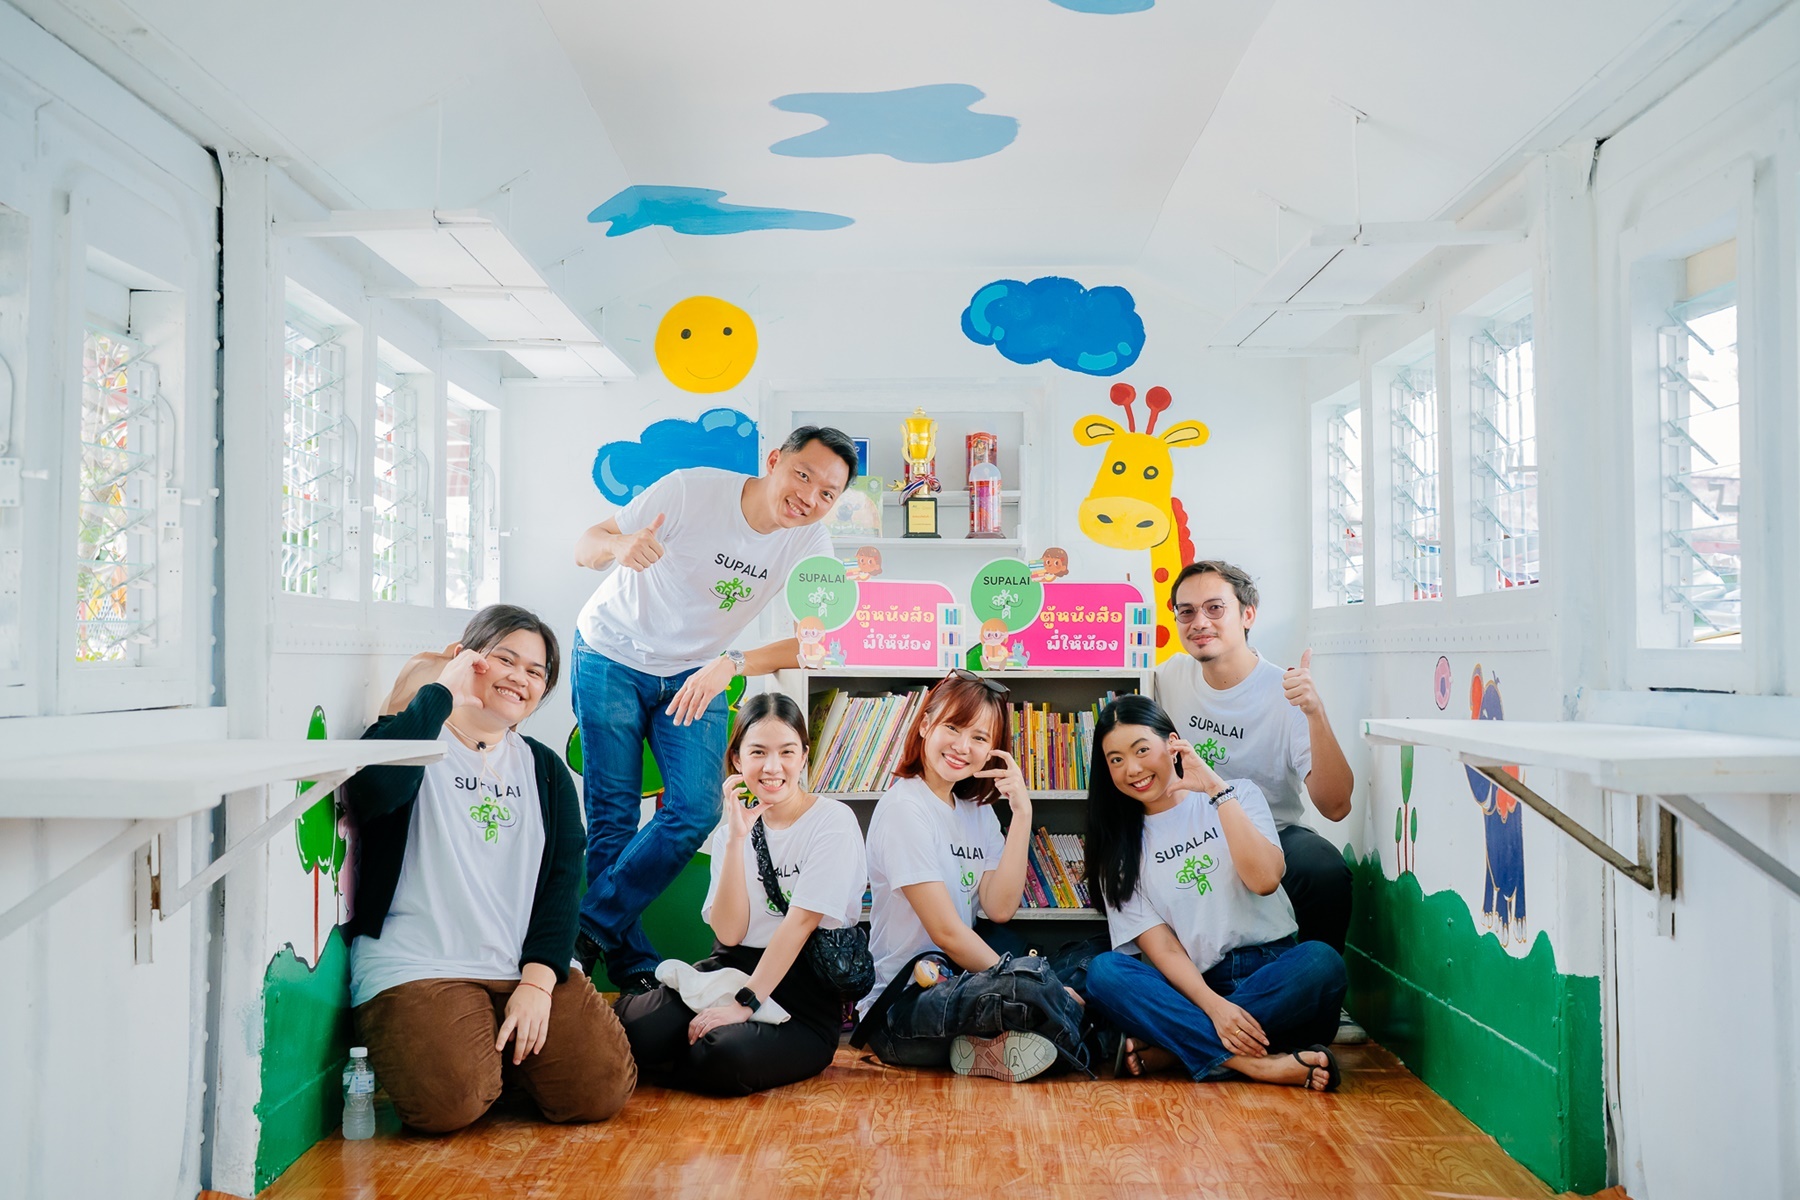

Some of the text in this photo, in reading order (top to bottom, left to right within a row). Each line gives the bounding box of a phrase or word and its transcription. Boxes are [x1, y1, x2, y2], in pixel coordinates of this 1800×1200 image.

[714, 553, 768, 580] SUPALA
[798, 572, 845, 584] SUPALAI
[983, 576, 1030, 586] SUPALAI
[855, 604, 935, 628] ตู้หนังสือ
[1040, 605, 1123, 630] ตู้หนังสือ
[862, 627, 932, 651] พี่ให้น้อง
[1046, 629, 1119, 651] พี่ให้น้อง
[1188, 715, 1244, 740] SUPALAI
[454, 776, 521, 799] SULAI
[1154, 826, 1219, 864] SUPALAI
